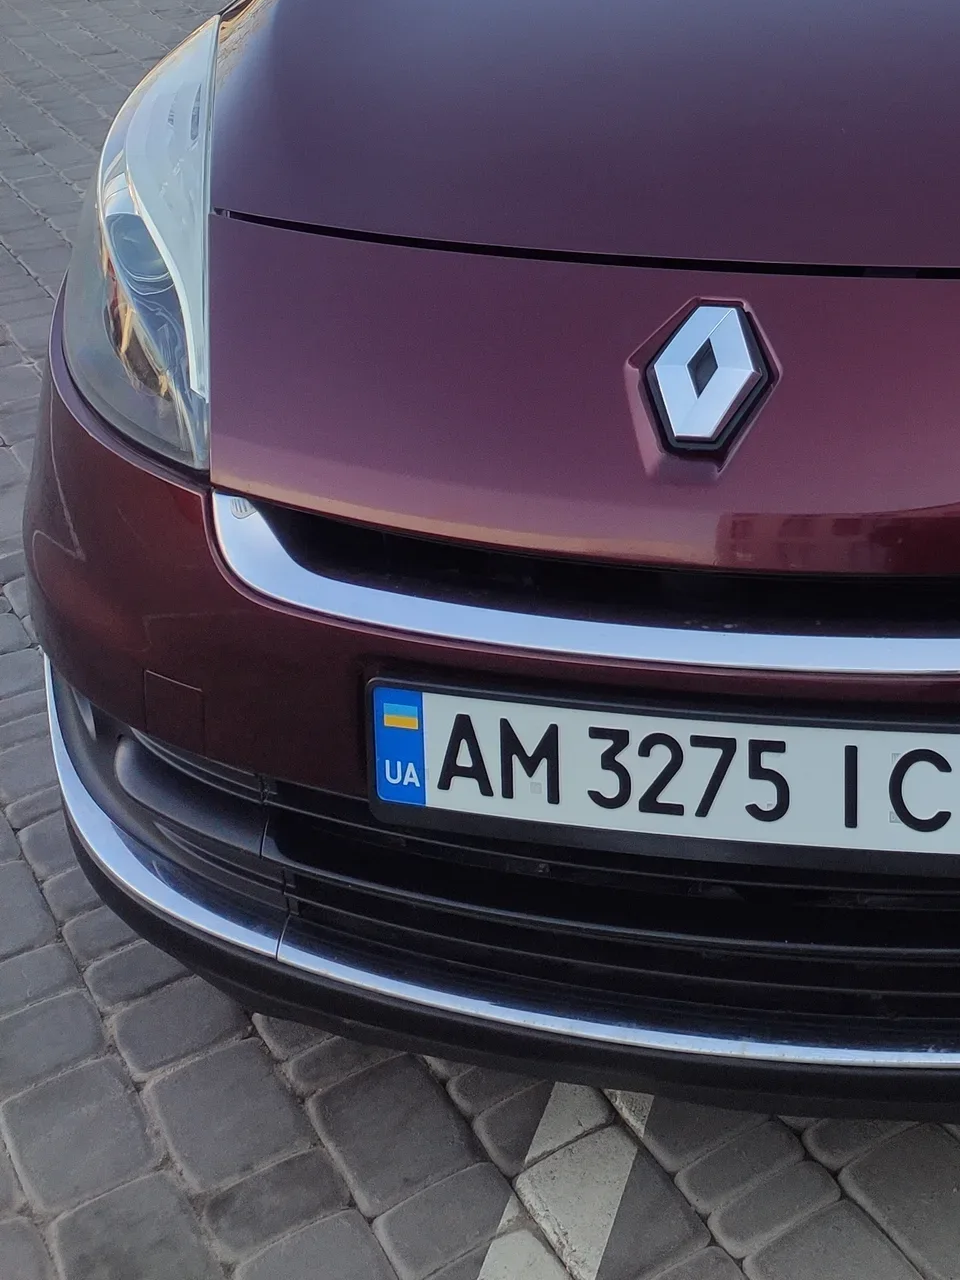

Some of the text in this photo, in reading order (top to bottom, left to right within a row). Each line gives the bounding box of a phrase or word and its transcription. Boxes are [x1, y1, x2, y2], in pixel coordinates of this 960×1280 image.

[385, 759, 421, 788] UA
[436, 713, 953, 833] AM 3275 IC
